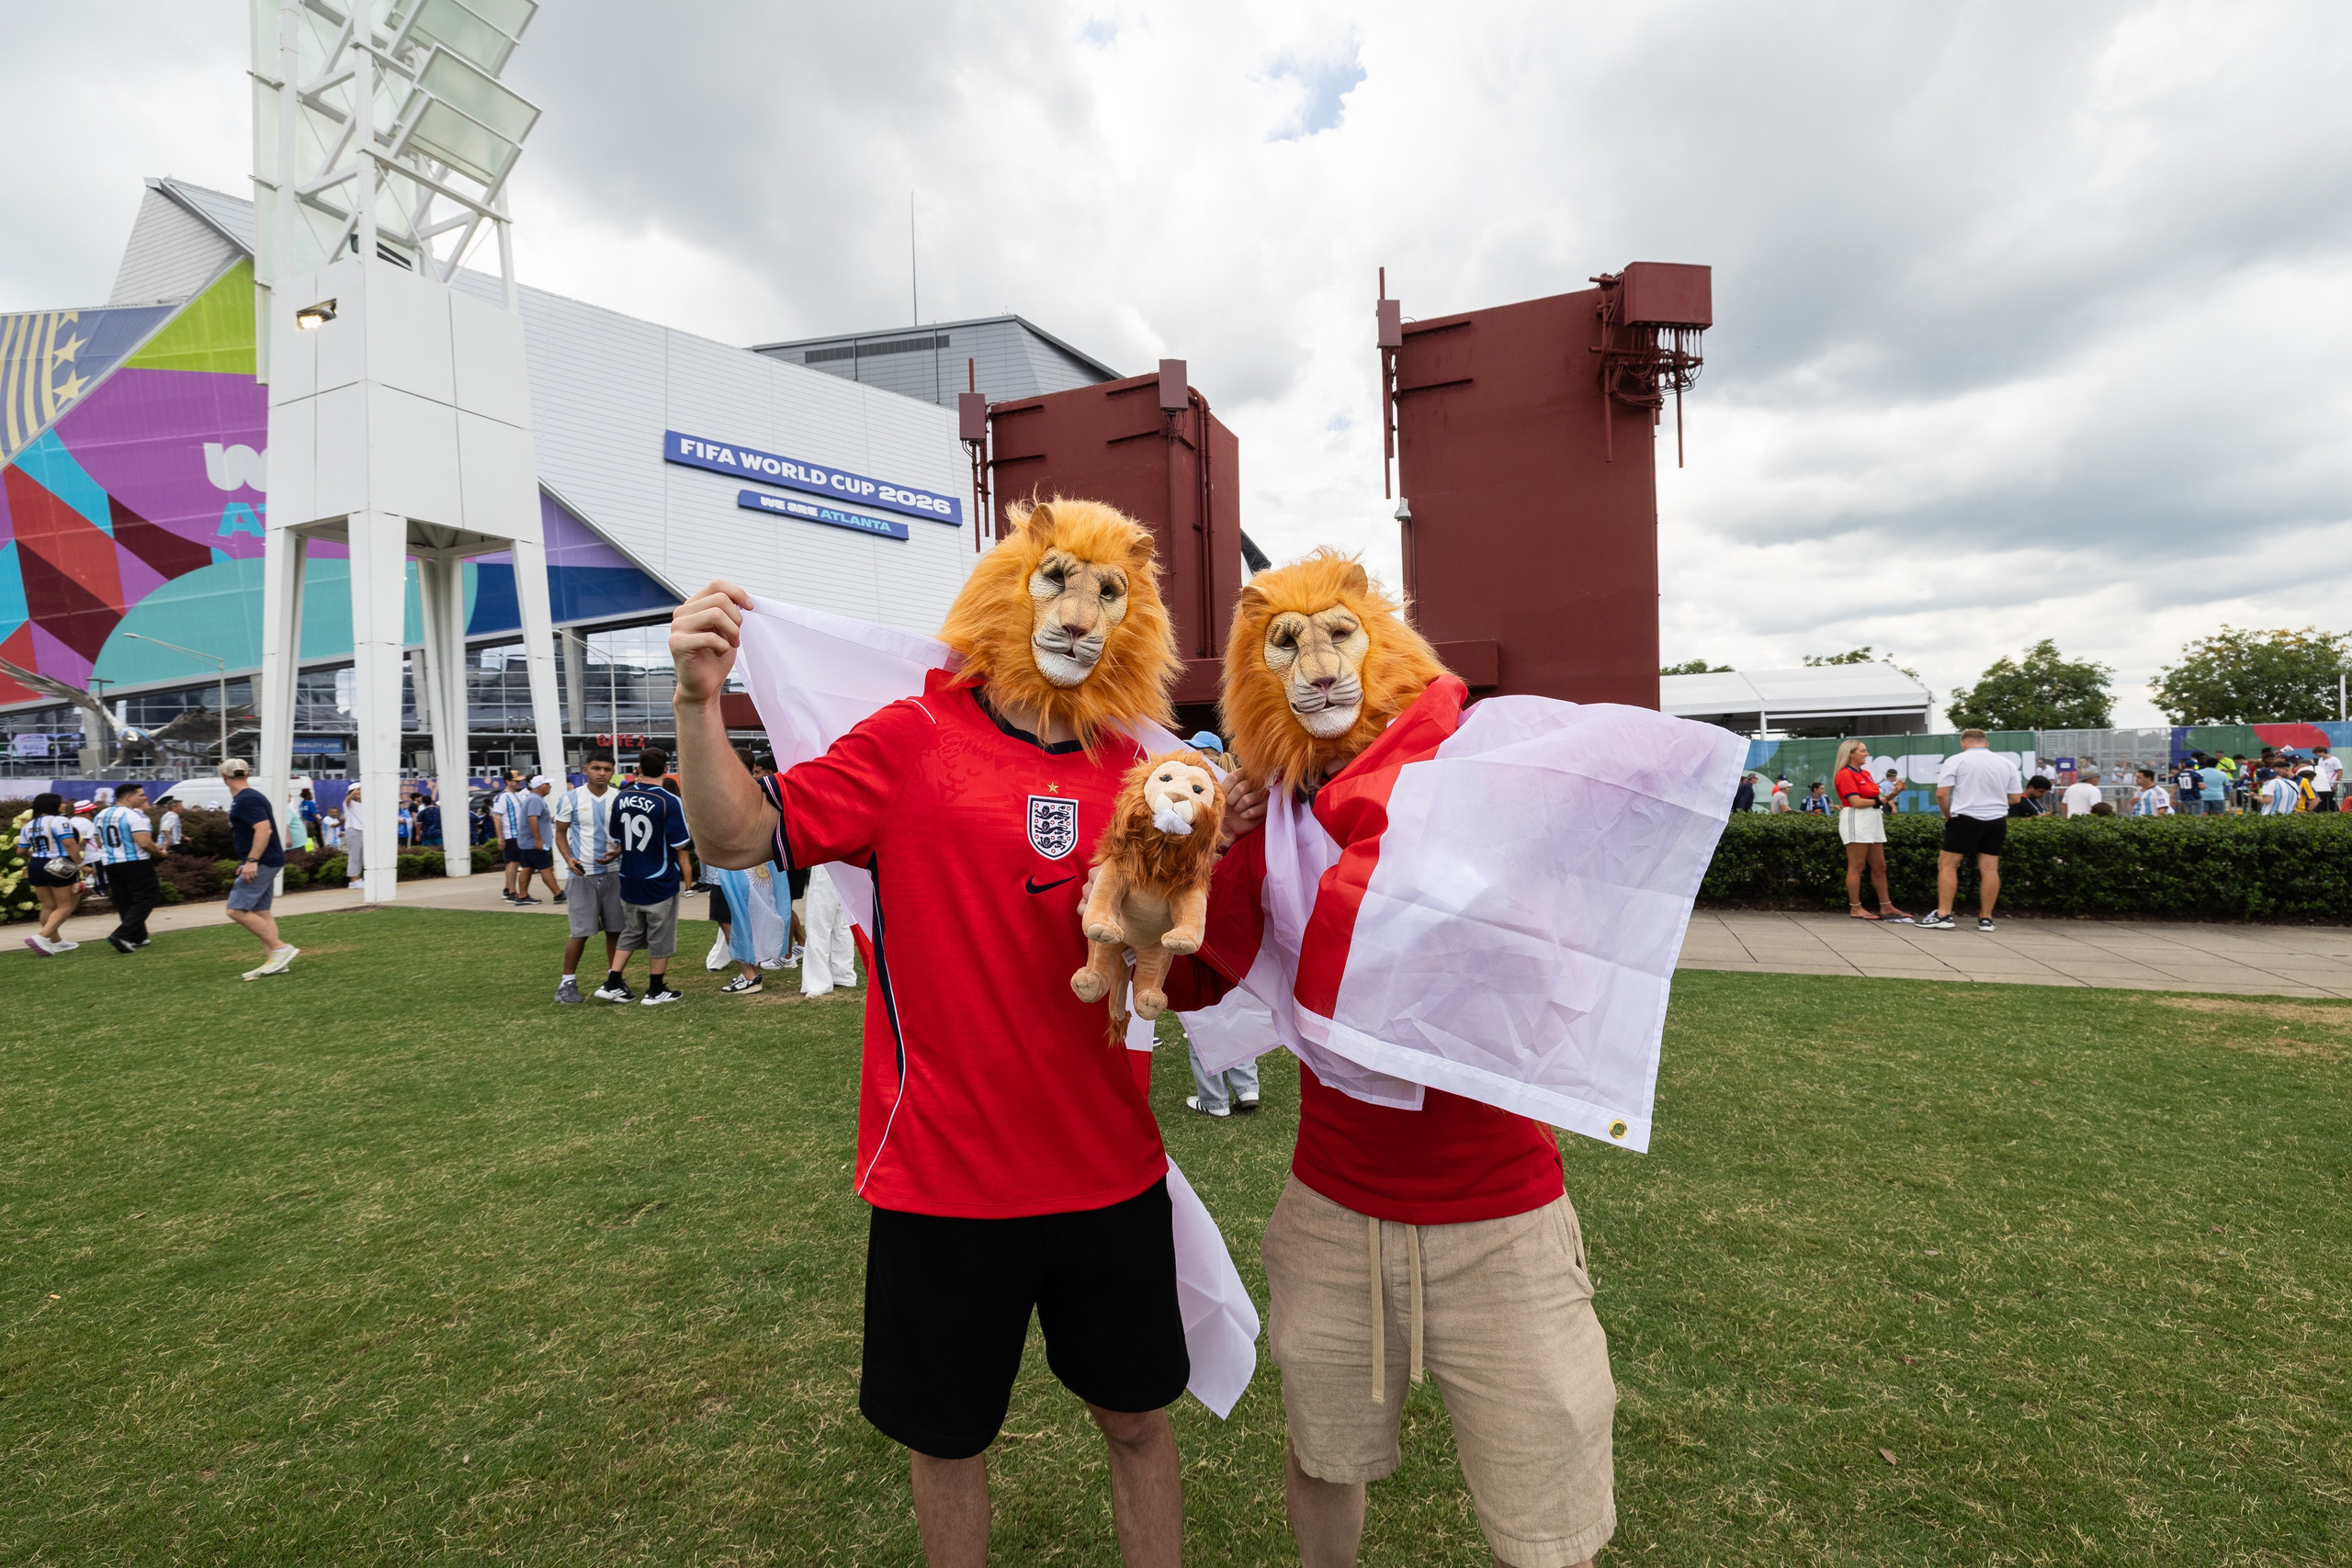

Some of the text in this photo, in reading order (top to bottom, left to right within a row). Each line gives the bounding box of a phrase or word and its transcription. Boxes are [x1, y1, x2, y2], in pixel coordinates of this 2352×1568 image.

[680, 437, 952, 514] FIFA WORLD CUP 2026
[760, 496, 786, 511] WE
[820, 509, 892, 532] ATLANTA
[597, 734, 646, 747] GATE 2
[2177, 776, 2192, 790] 10
[618, 795, 656, 814] MESSI
[619, 812, 653, 852] 19
